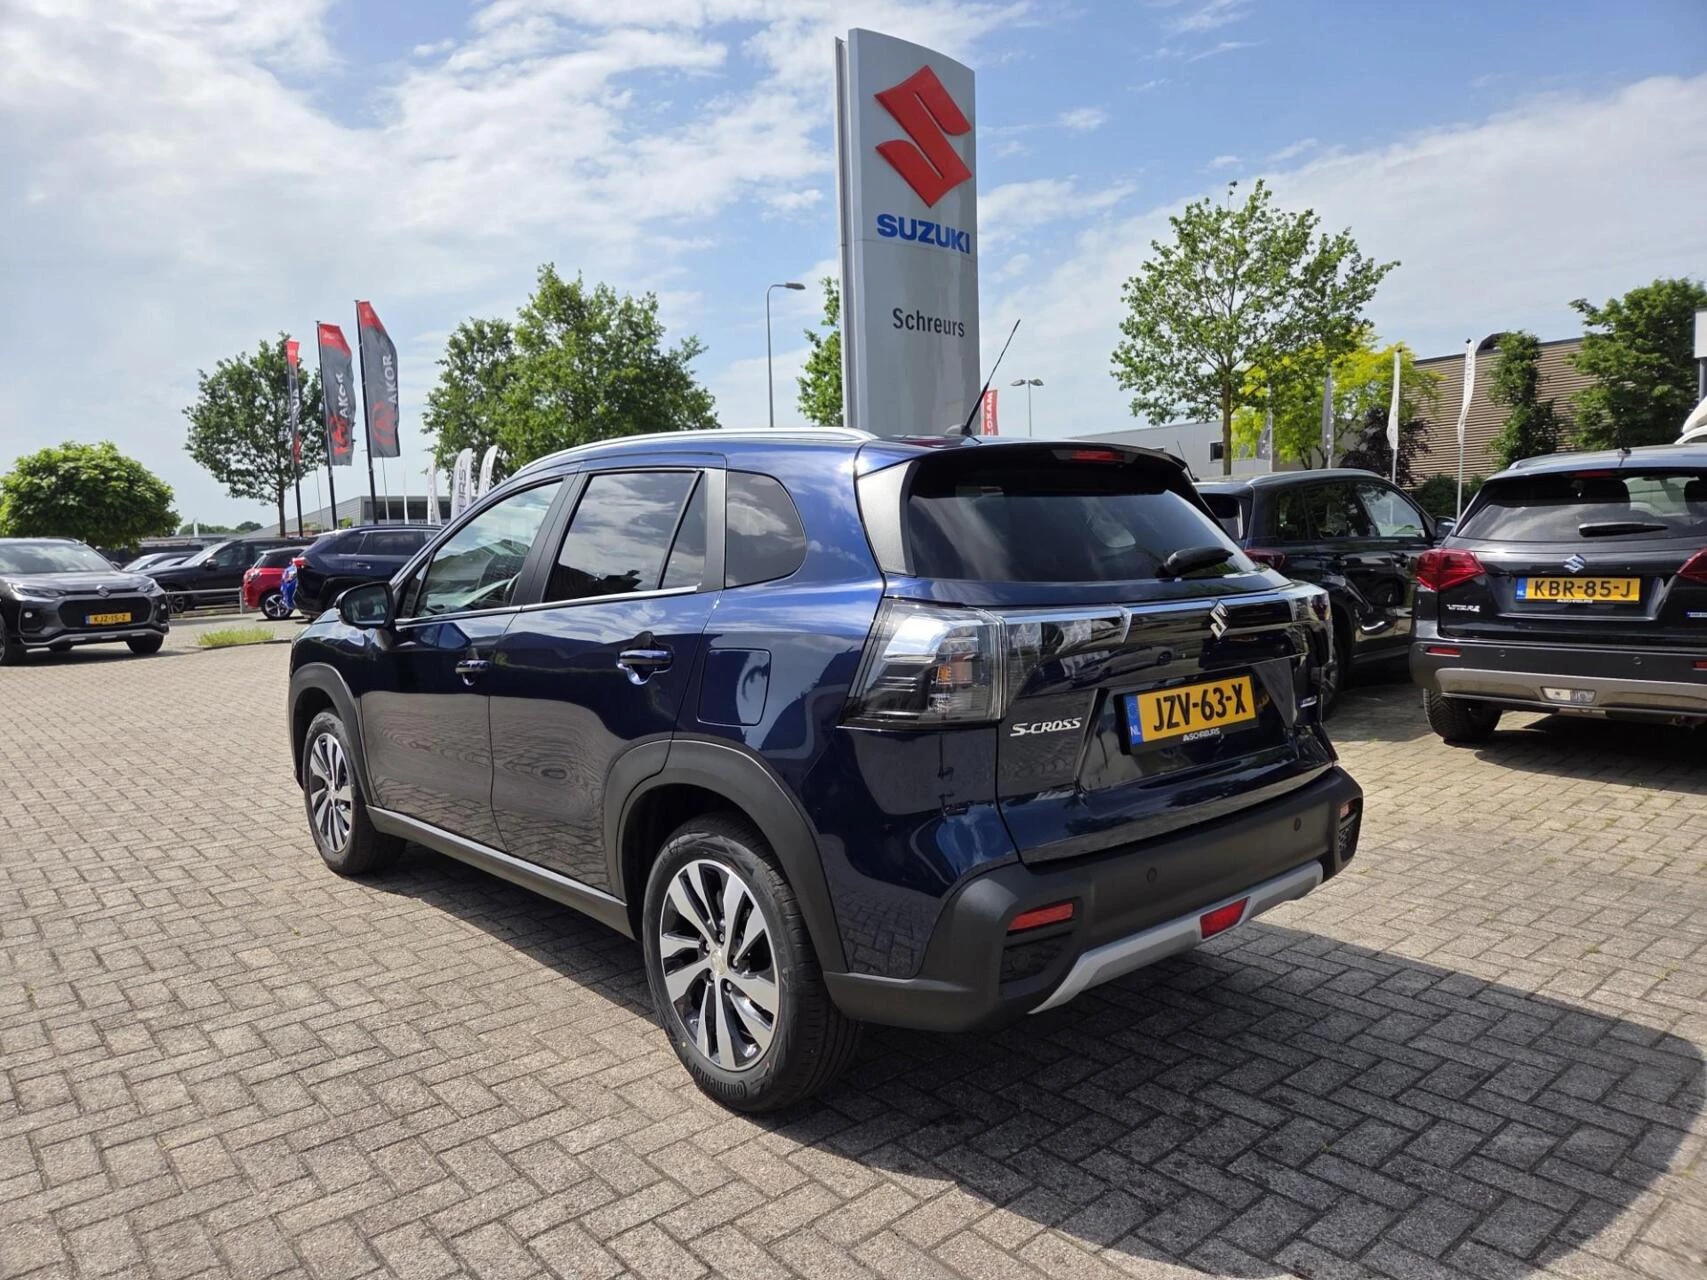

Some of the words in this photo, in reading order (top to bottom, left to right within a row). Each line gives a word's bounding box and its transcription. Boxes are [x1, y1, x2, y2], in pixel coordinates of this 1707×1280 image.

[877, 213, 970, 254] SUZUKI
[892, 307, 965, 338] Schreurs
[382, 354, 398, 405] AKOR
[1534, 580, 1631, 598] KBR-85-J
[1153, 683, 1247, 732] JZV-63-X
[1009, 717, 1083, 737] S-CROSS
[1130, 726, 1141, 736] NL
